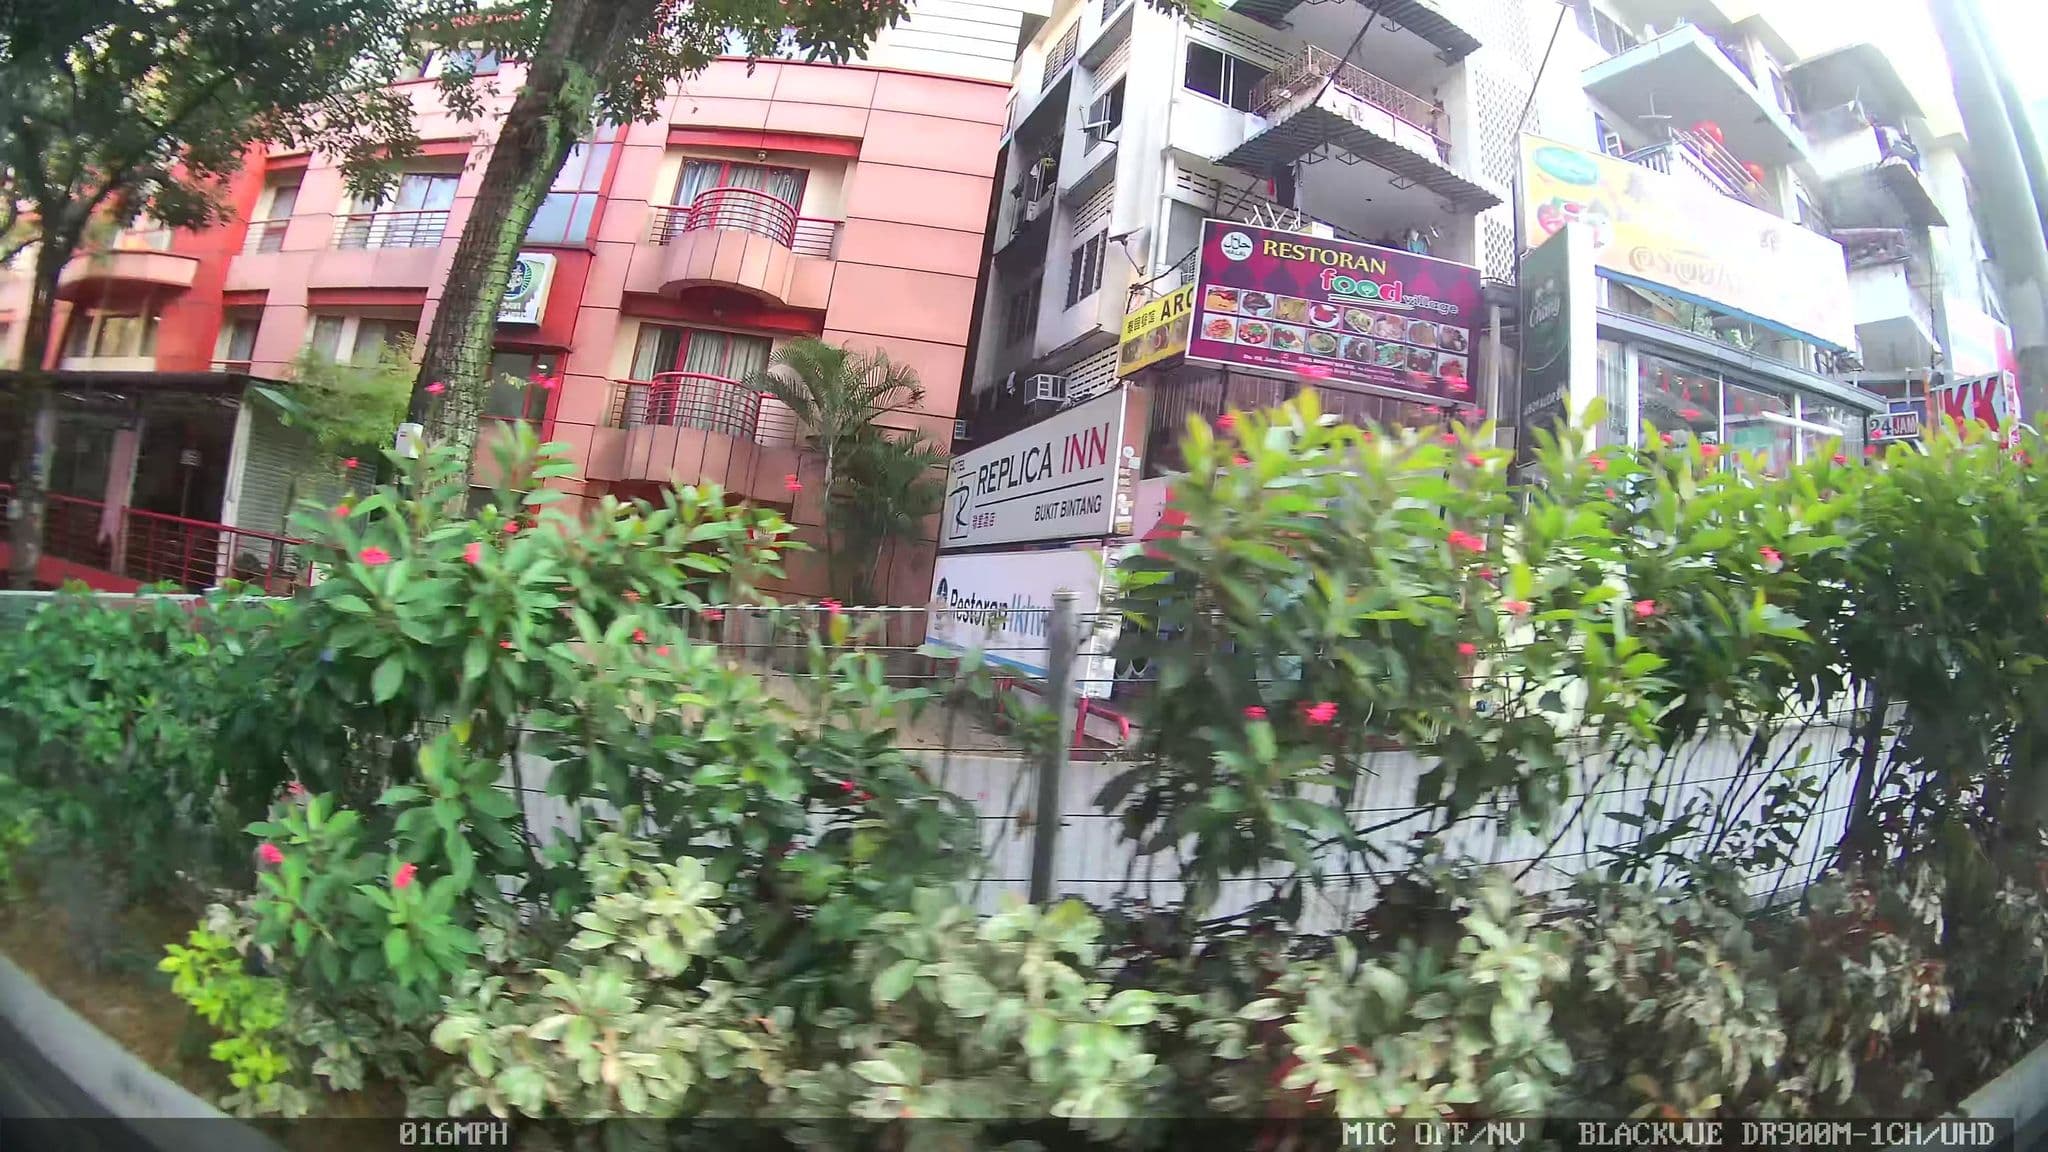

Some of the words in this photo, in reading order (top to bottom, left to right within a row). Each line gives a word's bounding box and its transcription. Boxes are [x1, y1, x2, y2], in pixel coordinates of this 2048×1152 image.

[1263, 239, 1387, 276] RESTORAN
[1320, 268, 1403, 304] food
[1402, 294, 1460, 316] village
[1893, 415, 1918, 435] JAM
[950, 459, 966, 474] HOTEL
[976, 443, 1053, 496] REPLICA
[1061, 422, 1111, 475] INN
[1034, 501, 1061, 522] BUKIT
[1060, 494, 1103, 519] BINTANG
